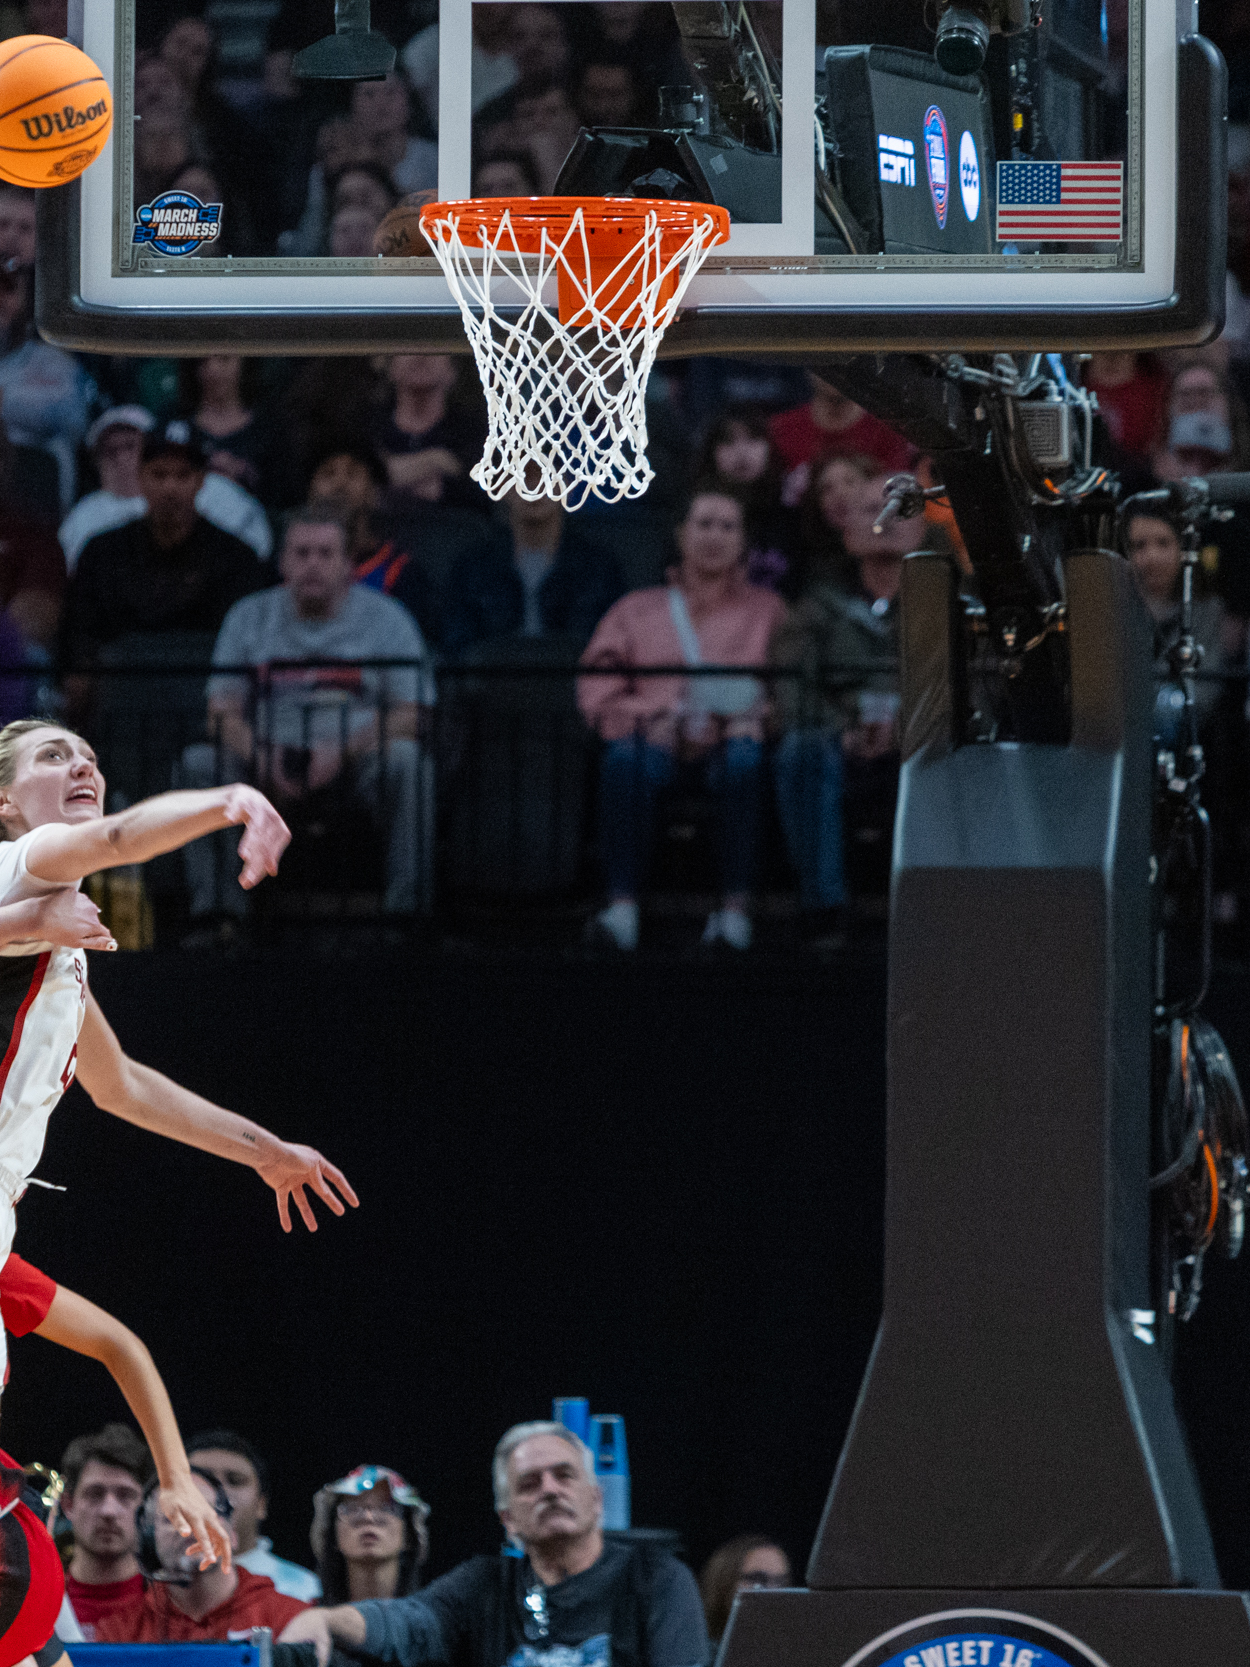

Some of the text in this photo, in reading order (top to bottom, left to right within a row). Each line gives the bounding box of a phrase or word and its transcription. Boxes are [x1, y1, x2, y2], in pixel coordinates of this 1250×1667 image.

[20, 98, 108, 141] Wilson
[878, 133, 916, 187] ESPN
[152, 208, 198, 223] MARCH
[157, 222, 219, 236] MADNESS
[903, 1640, 995, 1667] SWEET
